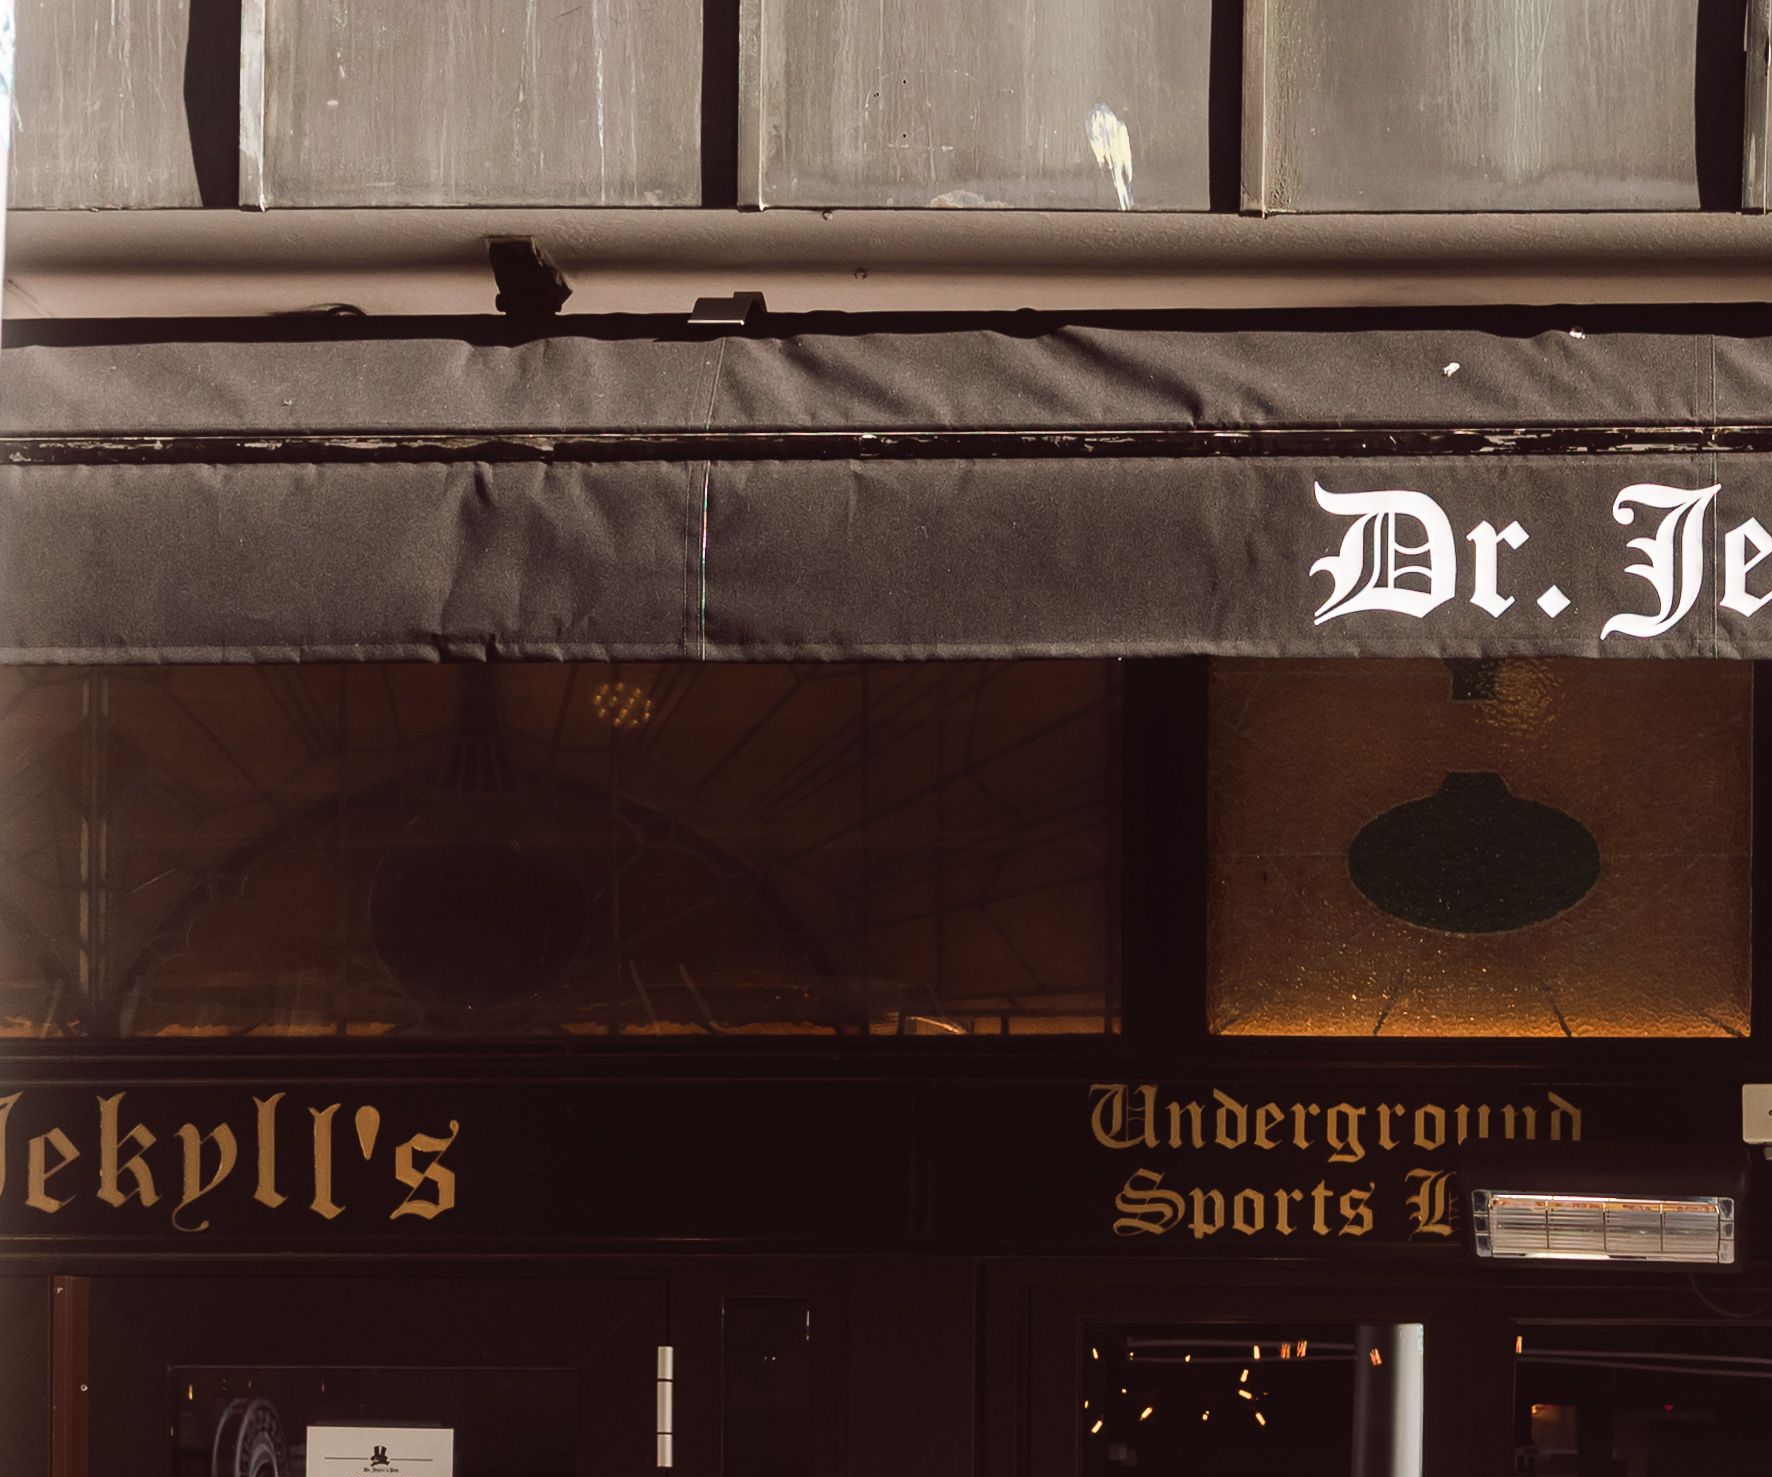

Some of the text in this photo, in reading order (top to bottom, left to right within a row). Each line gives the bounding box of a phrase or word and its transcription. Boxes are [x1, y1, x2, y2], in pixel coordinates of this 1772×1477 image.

[1310, 480, 1571, 626] Dr.
[1088, 1084, 1582, 1163] Underground
[1113, 1167, 1375, 1239] Sports
